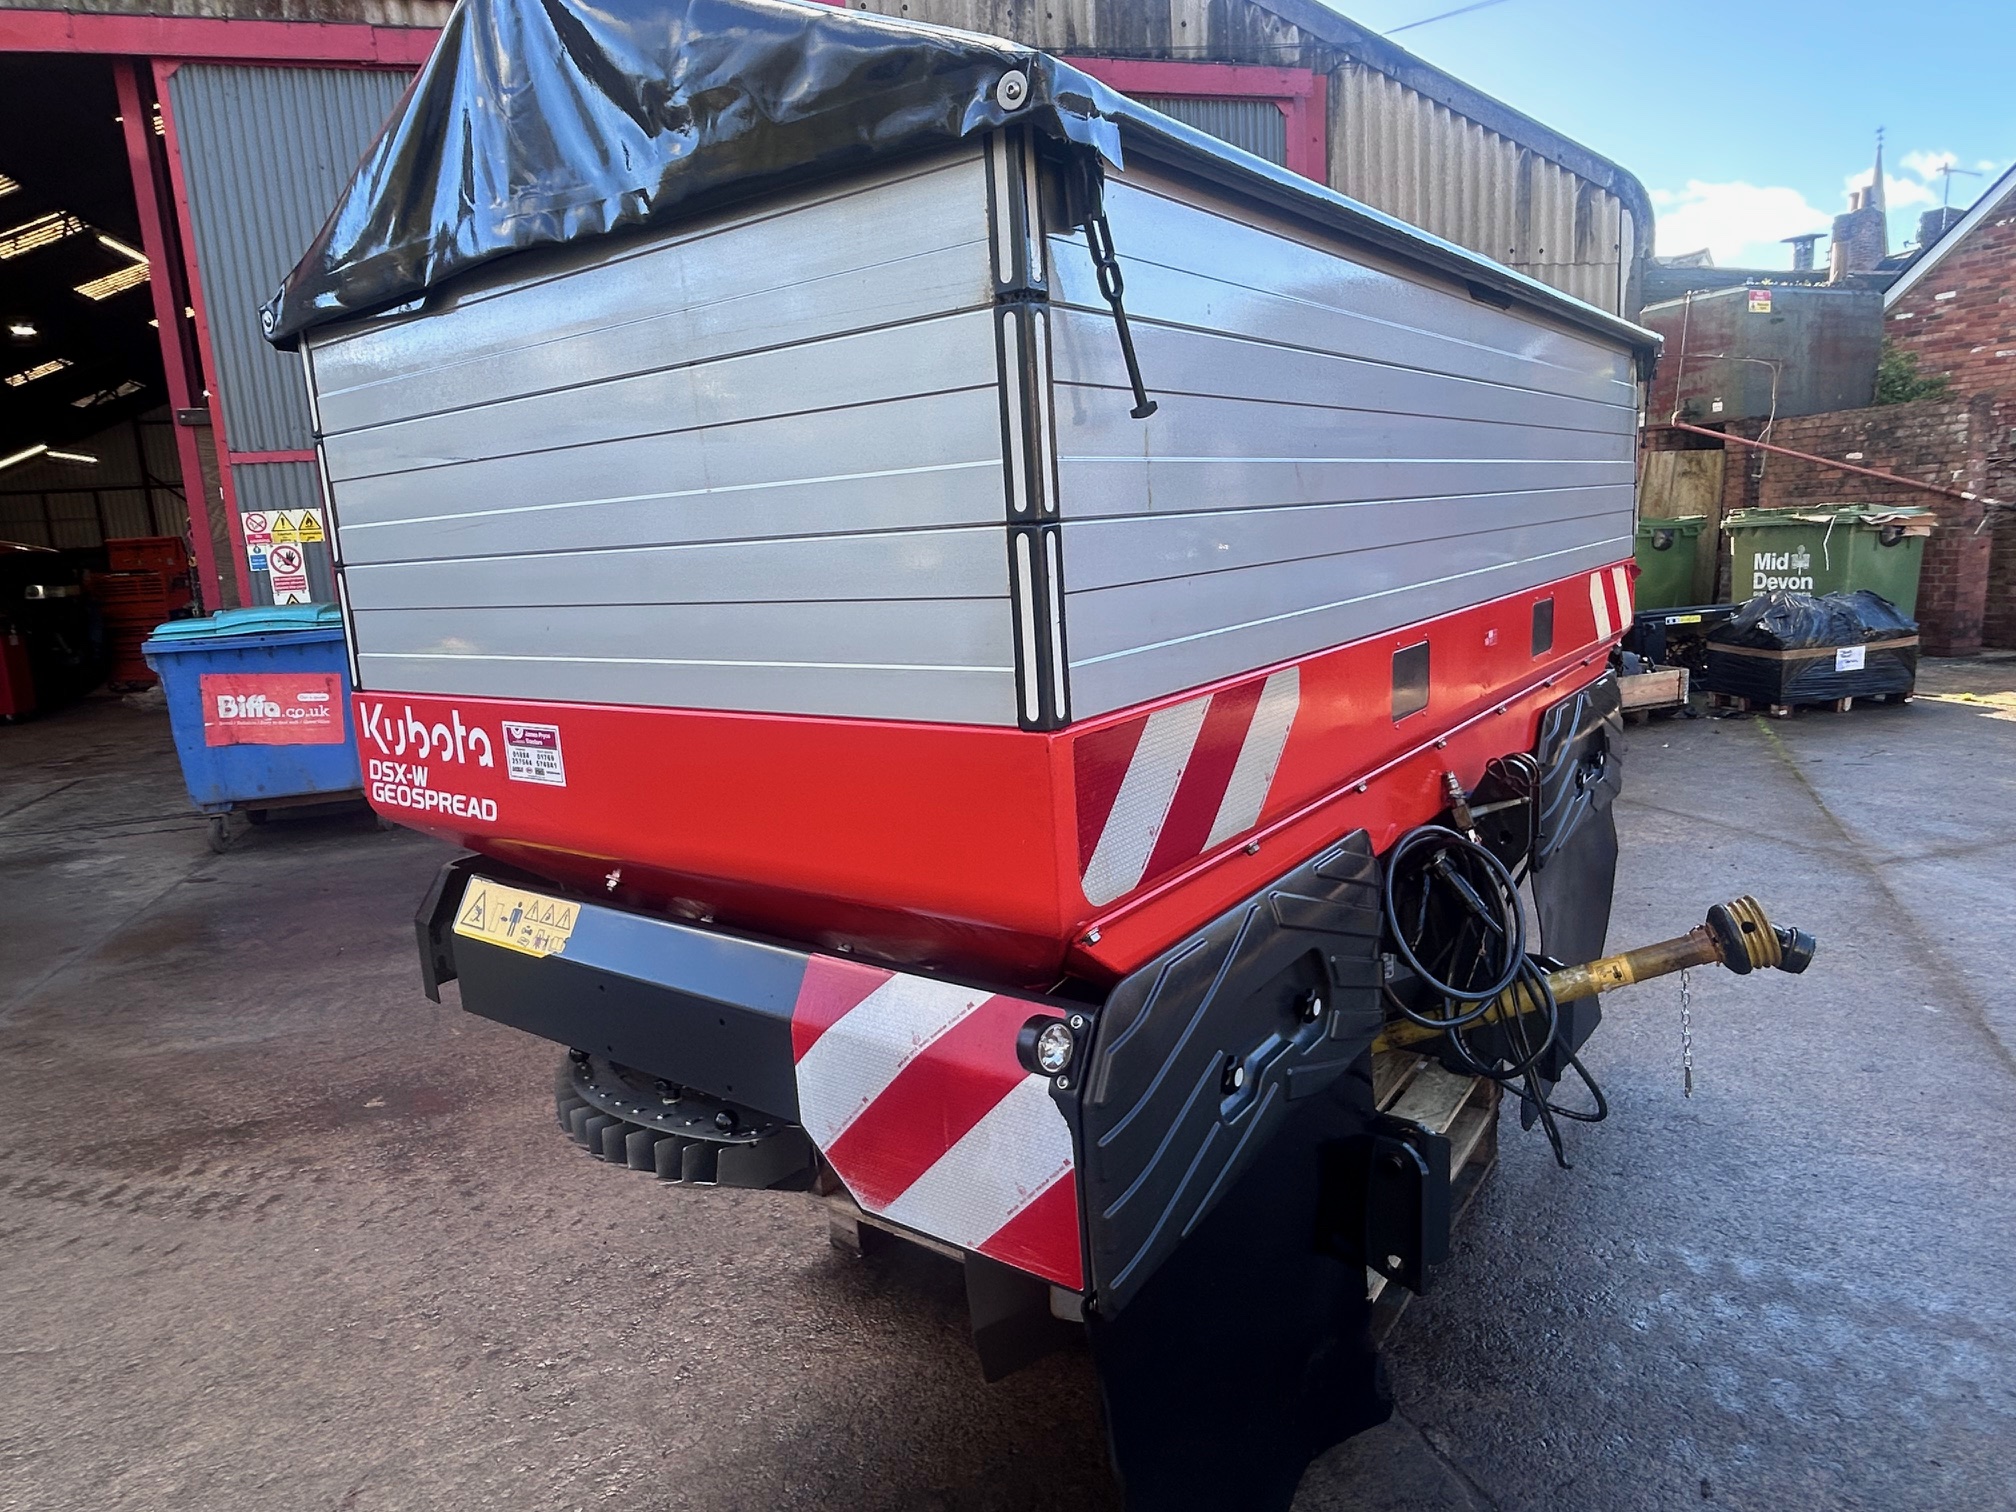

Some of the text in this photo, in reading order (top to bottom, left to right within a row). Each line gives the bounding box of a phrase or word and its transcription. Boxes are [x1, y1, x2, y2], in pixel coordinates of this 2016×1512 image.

[1754, 552, 1789, 570] Mid
[1753, 572, 1813, 589] Devon
[359, 701, 495, 768] Kubota
[369, 759, 429, 788] DSX-W
[372, 781, 498, 822] GEOSPREAD
